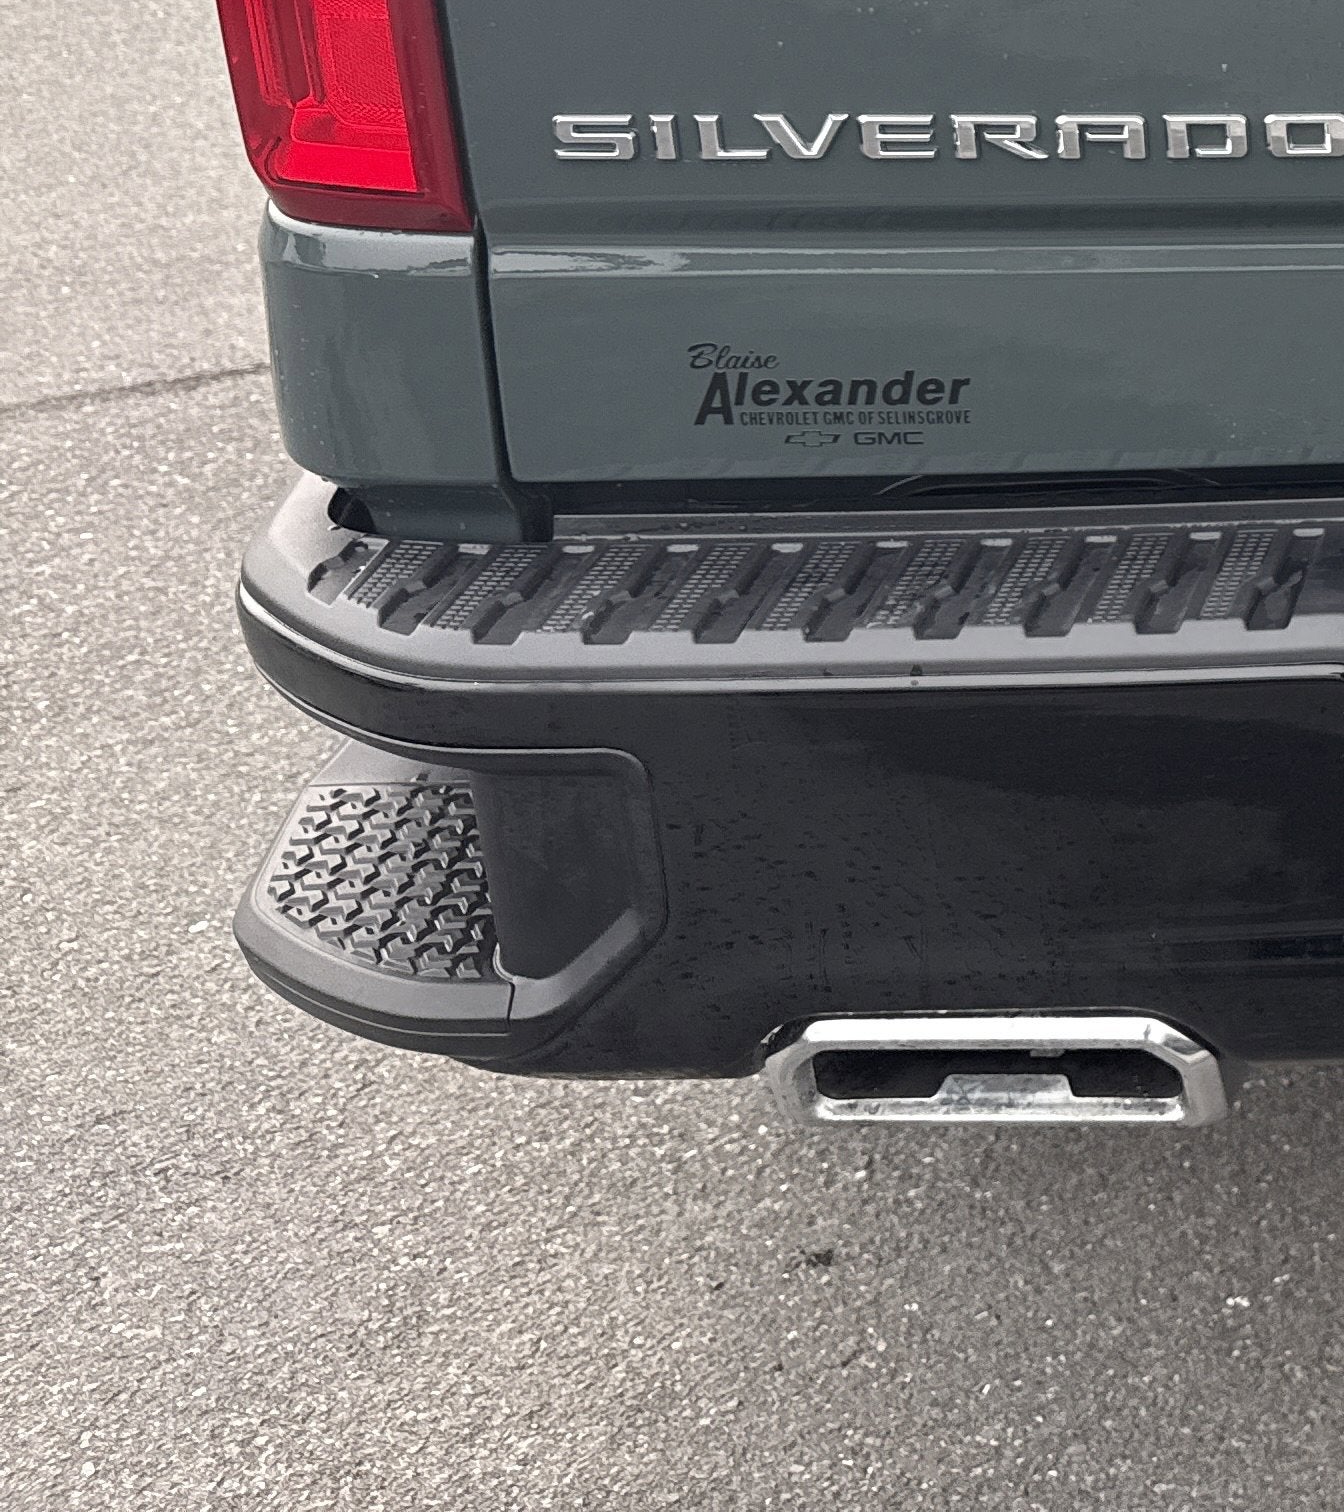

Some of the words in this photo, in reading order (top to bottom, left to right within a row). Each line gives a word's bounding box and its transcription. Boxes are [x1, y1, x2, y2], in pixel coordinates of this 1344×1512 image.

[687, 342, 780, 370] Blaise
[693, 370, 971, 426] Alexander
[740, 412, 819, 426] CHEVROLET
[823, 411, 855, 425] GMC
[859, 411, 876, 425] OF
[878, 410, 972, 425] SELINSGROVE
[854, 432, 925, 446] GMC
